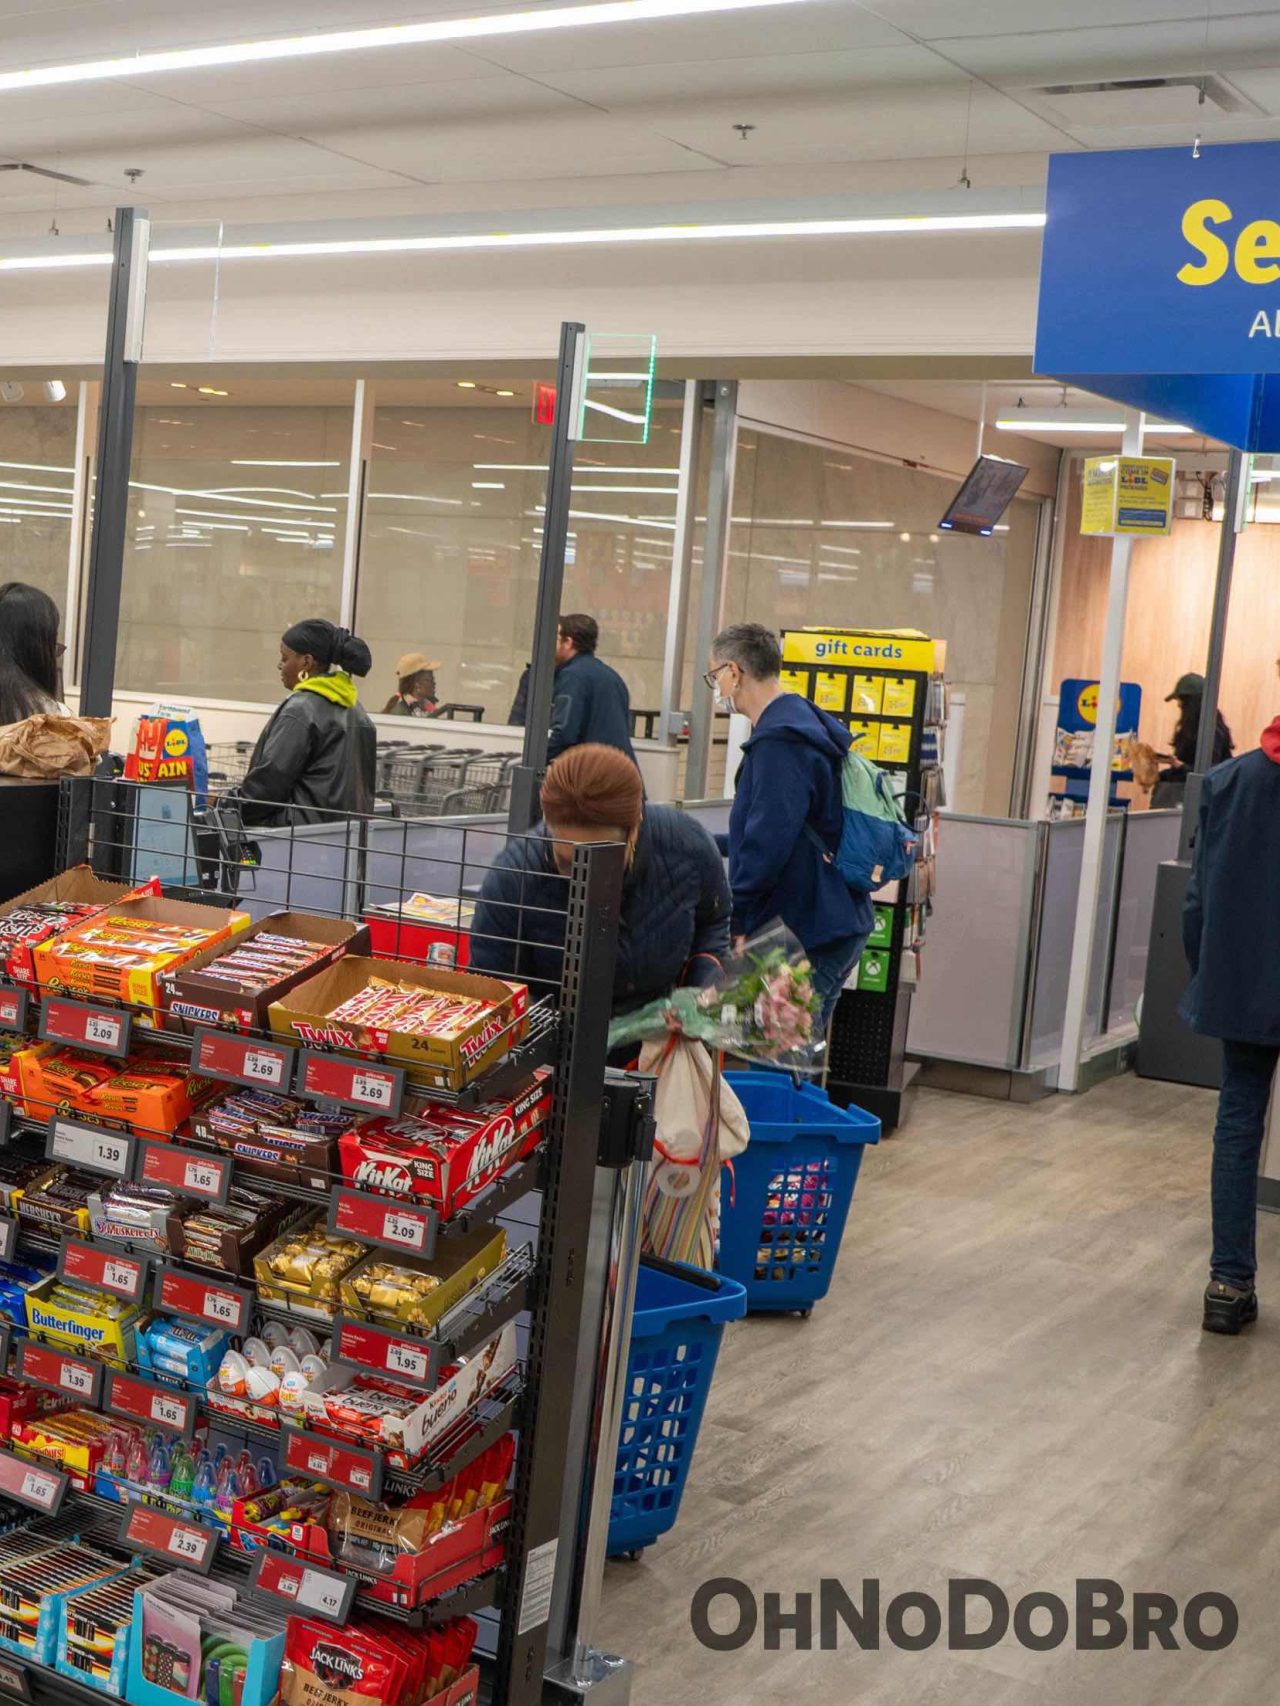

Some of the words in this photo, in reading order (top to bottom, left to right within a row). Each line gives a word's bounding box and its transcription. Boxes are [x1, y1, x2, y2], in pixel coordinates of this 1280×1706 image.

[815, 639, 848, 657] gift
[853, 643, 902, 659] cards
[165, 983, 176, 995] 24
[172, 1003, 218, 1021] SNICKERS
[93, 1027, 112, 1040] 2.09
[411, 1038, 429, 1051] 24
[252, 1063, 273, 1076] 2.69
[360, 1086, 382, 1098] 2.69
[515, 1099, 530, 1117] KING
[530, 1086, 544, 1104] SIZE
[98, 1145, 120, 1161] 1.39
[237, 1144, 279, 1161] SNICKERS
[414, 1160, 434, 1171] KING
[193, 1173, 211, 1186] 1.65
[417, 1169, 434, 1180] SIZE
[20, 1201, 61, 1224] HERSHEY'S
[106, 1223, 159, 1239] Musketeers
[392, 1225, 415, 1239] 2.09
[111, 1272, 128, 1285] 1.65
[212, 1304, 231, 1317] 1.65
[32, 1308, 105, 1341] Butterfinger
[396, 1356, 417, 1370] 1.95
[69, 1374, 84, 1387] 1.39
[343, 1397, 384, 1411] bueno
[160, 1407, 177, 1421] 1.65
[421, 1389, 458, 1436] bueno
[30, 1484, 47, 1497] 1.65
[384, 1480, 418, 1497] LINKS
[177, 1539, 198, 1553] 2.39
[321, 1596, 337, 1607] 4.17
[310, 1646, 333, 1670] JACK
[333, 1651, 364, 1680] LINKS
[304, 1682, 323, 1696] BEEF
